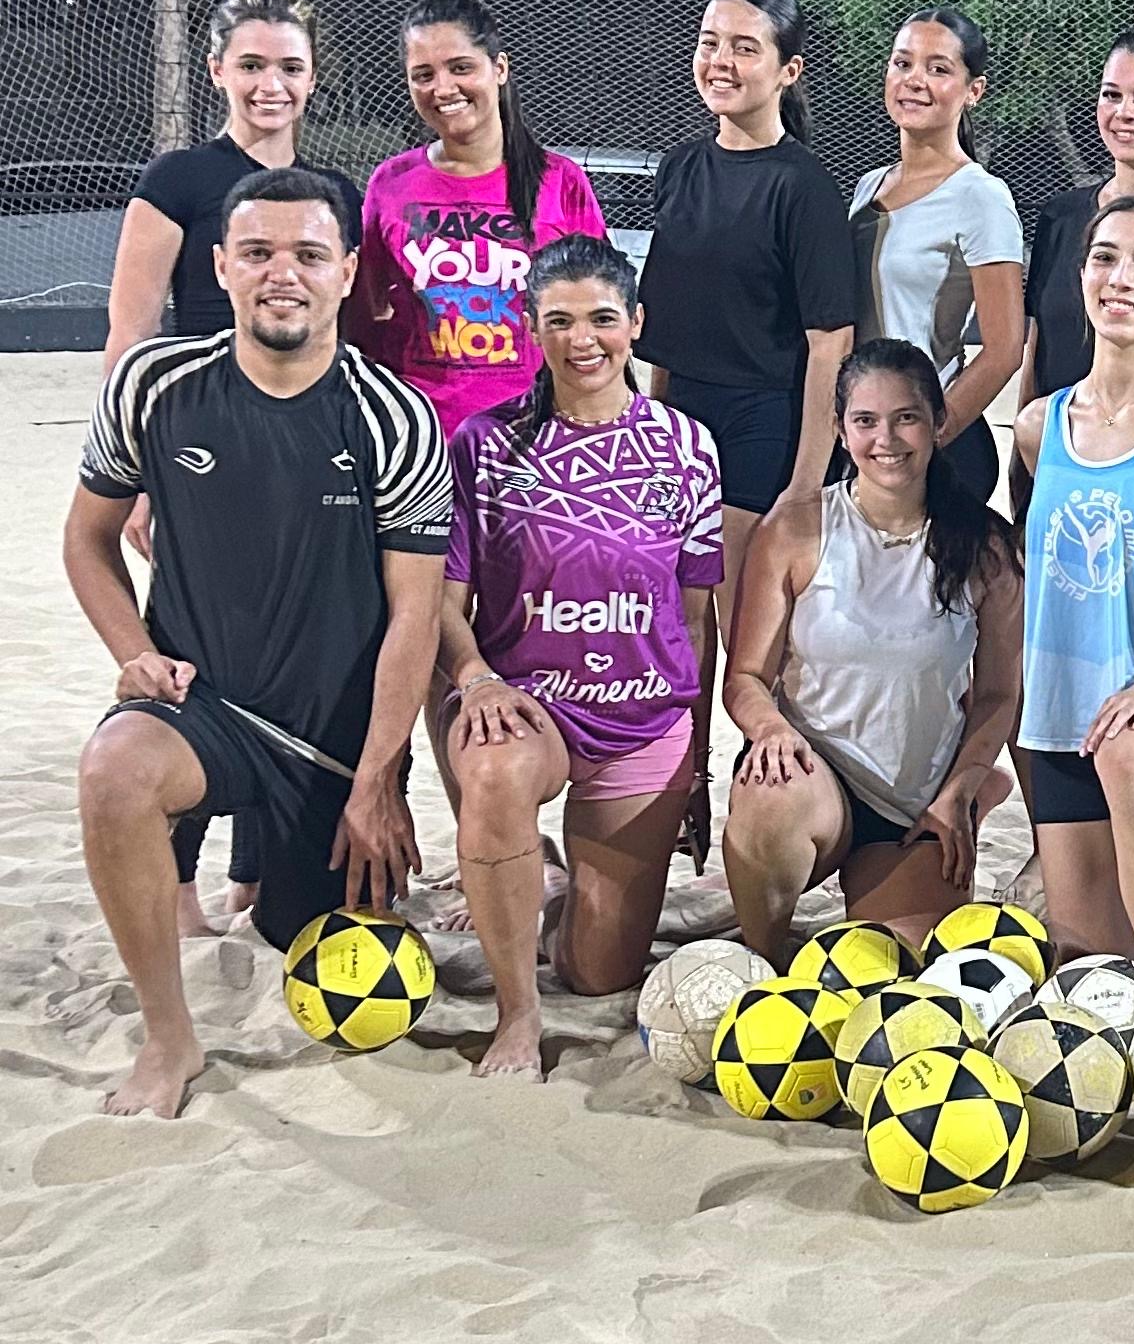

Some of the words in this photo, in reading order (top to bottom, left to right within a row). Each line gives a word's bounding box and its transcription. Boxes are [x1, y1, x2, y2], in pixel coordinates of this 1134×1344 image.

[407, 208, 525, 241] MAKE
[403, 237, 532, 292] YOUR
[410, 524, 424, 534] CT
[522, 590, 653, 635] Health
